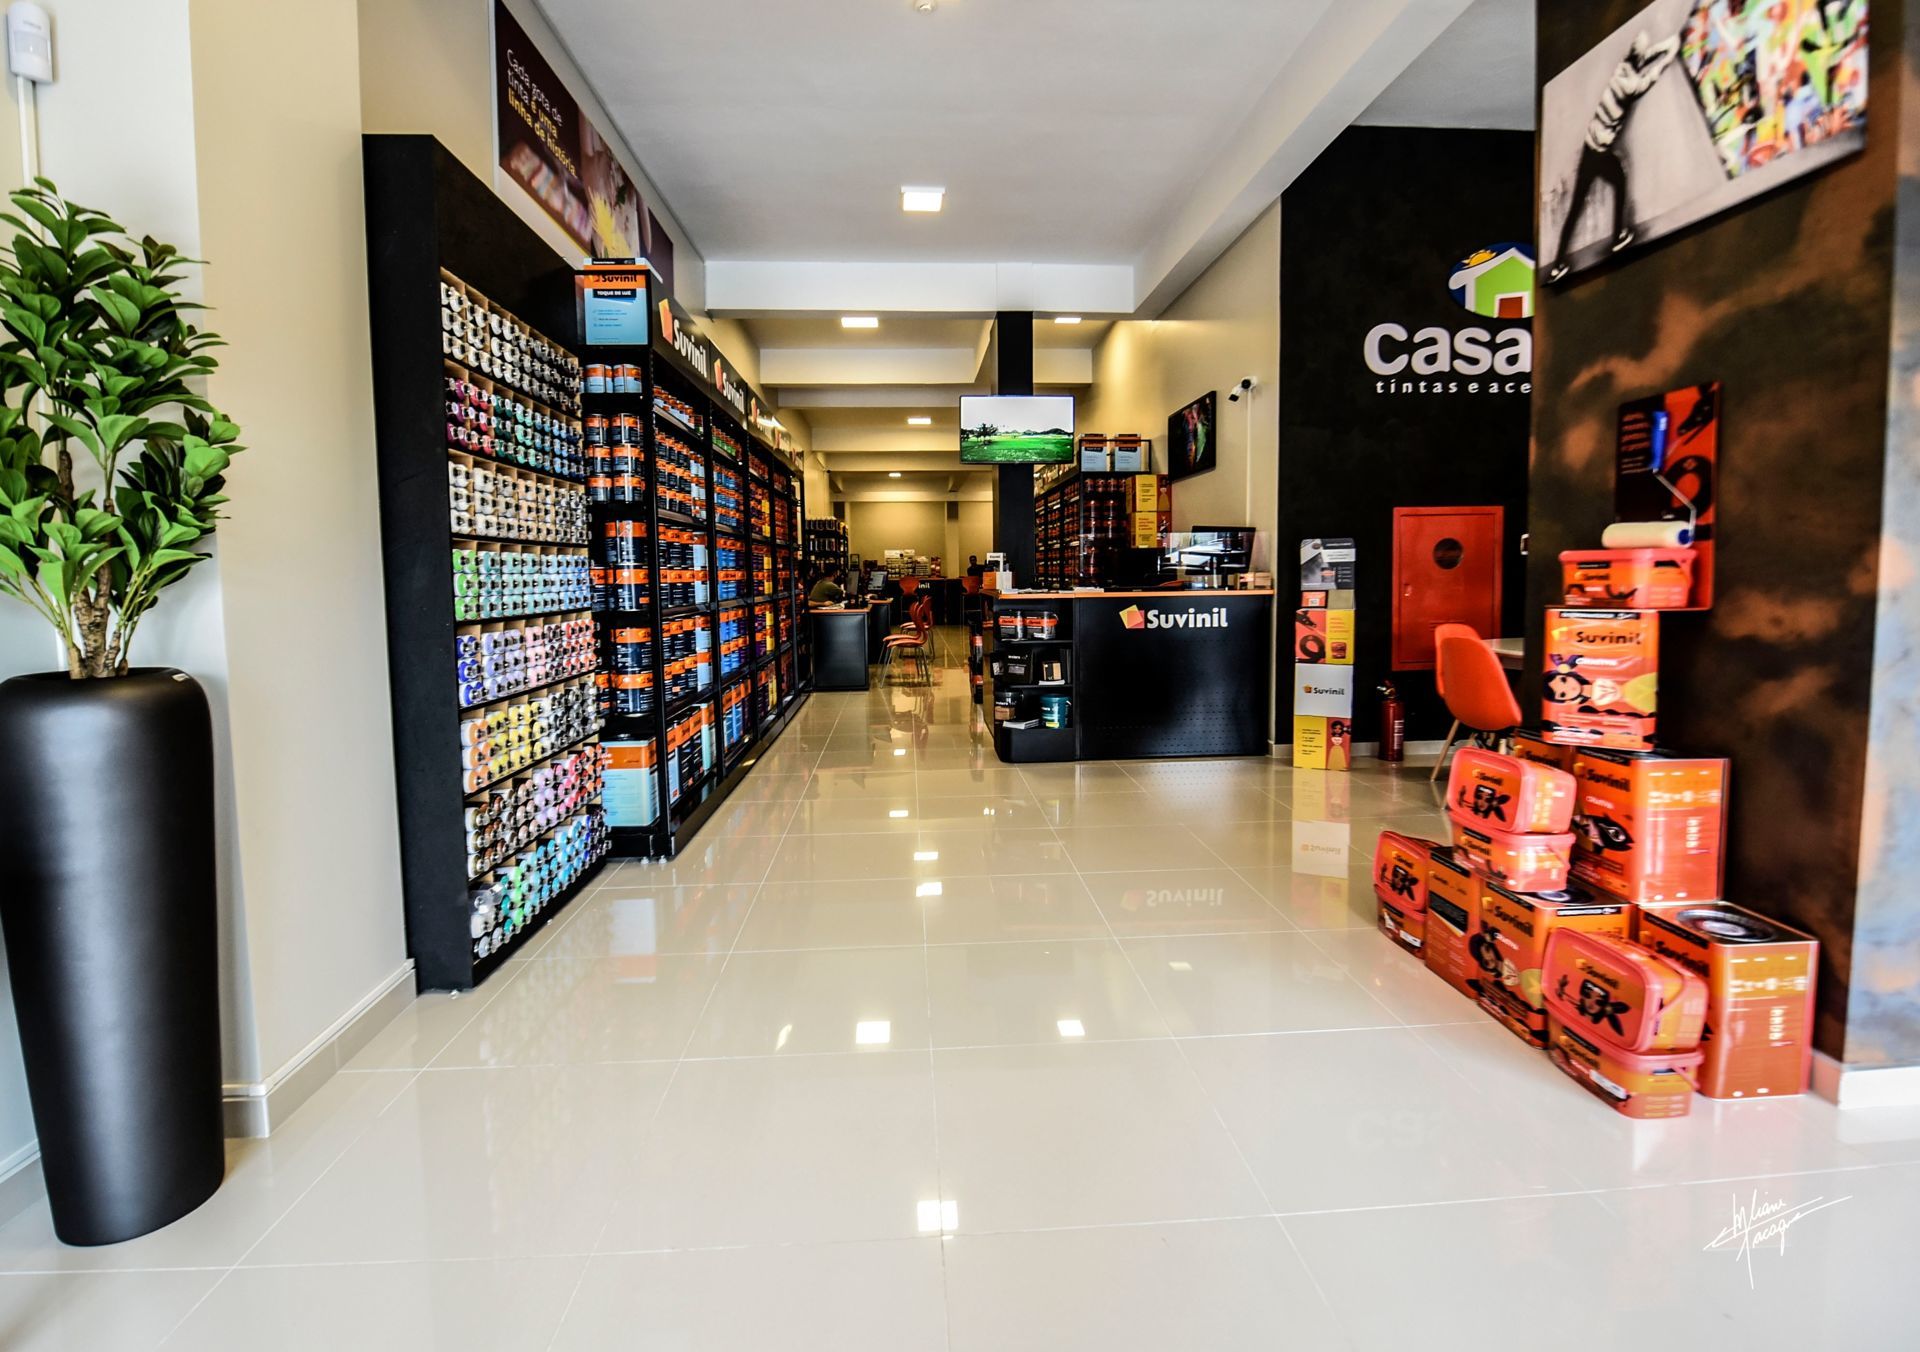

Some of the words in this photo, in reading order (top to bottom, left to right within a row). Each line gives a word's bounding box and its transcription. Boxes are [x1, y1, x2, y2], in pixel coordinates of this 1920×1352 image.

[507, 49, 531, 88] Cada
[531, 82, 551, 113] gota
[551, 107, 563, 127] de
[507, 68, 530, 106] tinta
[538, 108, 559, 139] uma
[508, 86, 533, 128] linha
[534, 123, 546, 142] de
[673, 318, 708, 379] Suvinil
[722, 372, 745, 415] Suvinil
[1488, 382, 1532, 394] ace
[1146, 607, 1229, 629] Suvinil
[1576, 631, 1642, 645] Suvinil
[1313, 687, 1345, 696] Suvinil
[1586, 768, 1631, 792] Suvinil
[1494, 905, 1535, 938] Suvinil
